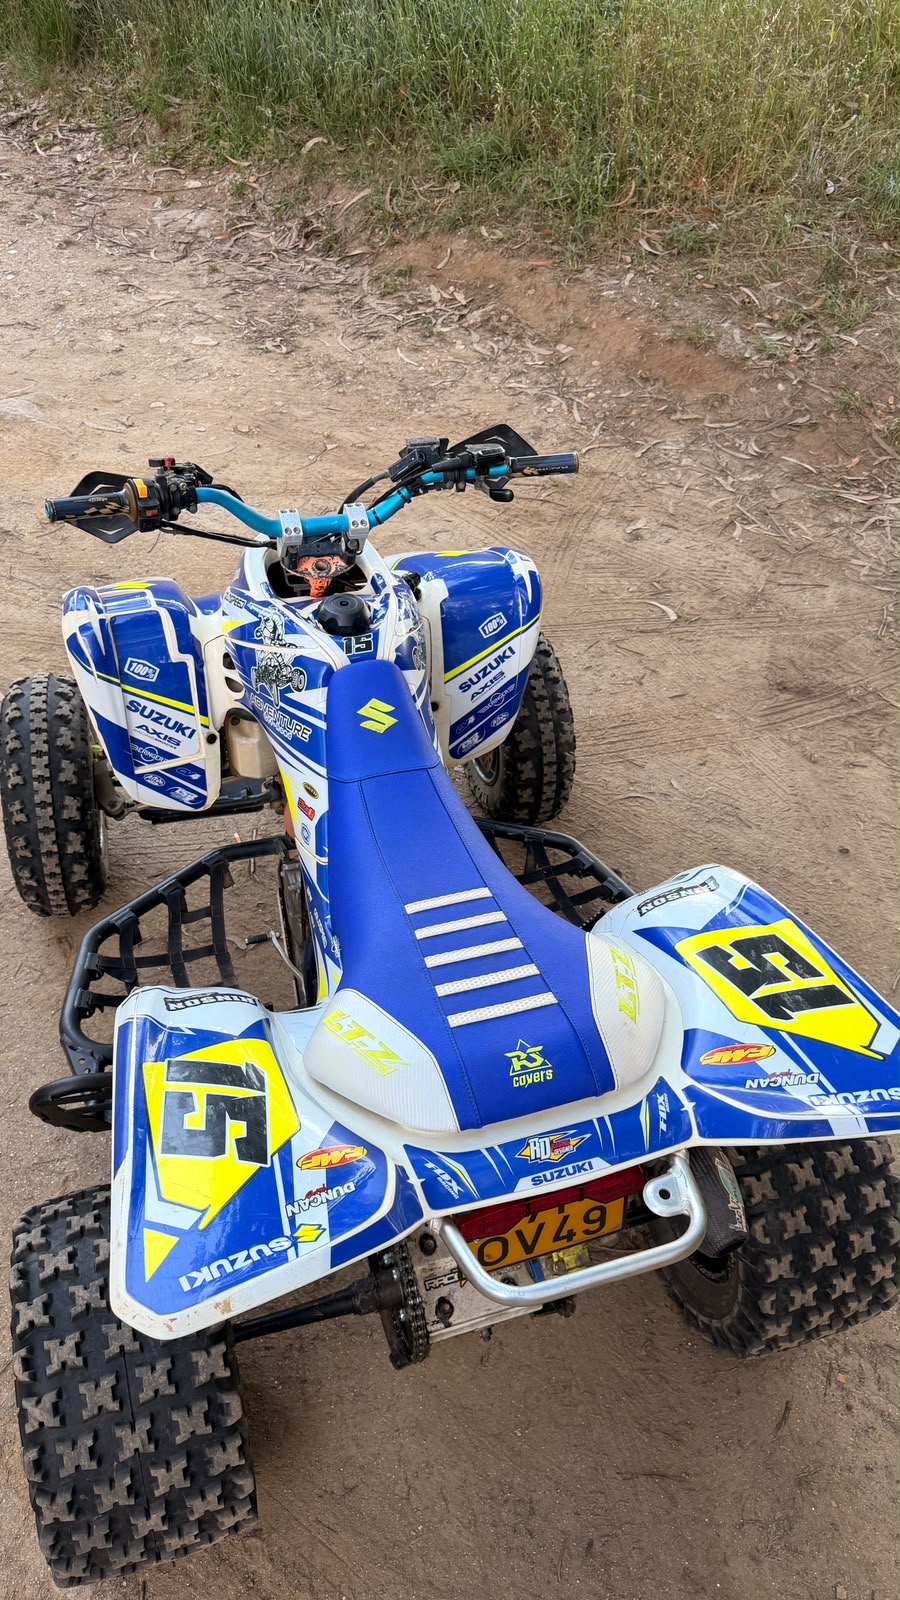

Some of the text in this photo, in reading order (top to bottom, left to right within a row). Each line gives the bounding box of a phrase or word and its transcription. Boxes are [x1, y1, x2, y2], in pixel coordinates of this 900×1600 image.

[483, 616, 506, 634] 100%
[342, 634, 373, 655] 15
[129, 661, 159, 681] 100%
[458, 646, 516, 693] SUZUKI
[470, 671, 505, 701] AXIS
[126, 700, 196, 739] SUZUKI
[250, 692, 312, 742] ADVENTURE
[136, 724, 181, 747] AXIS
[694, 932, 859, 1022] 15
[165, 993, 257, 1011] HINSON
[701, 1045, 775, 1066] FMF
[513, 1069, 553, 1089] covers
[745, 1072, 820, 1089] DUNCAN
[160, 1058, 271, 1167] 15
[657, 1093, 667, 1133] FOX
[301, 1146, 365, 1171] FMF
[424, 1162, 464, 1195] FOX
[531, 1161, 593, 1186] SUZUKI
[286, 1181, 356, 1219] DUNCAN
[178, 1236, 292, 1292] SUZUKI
